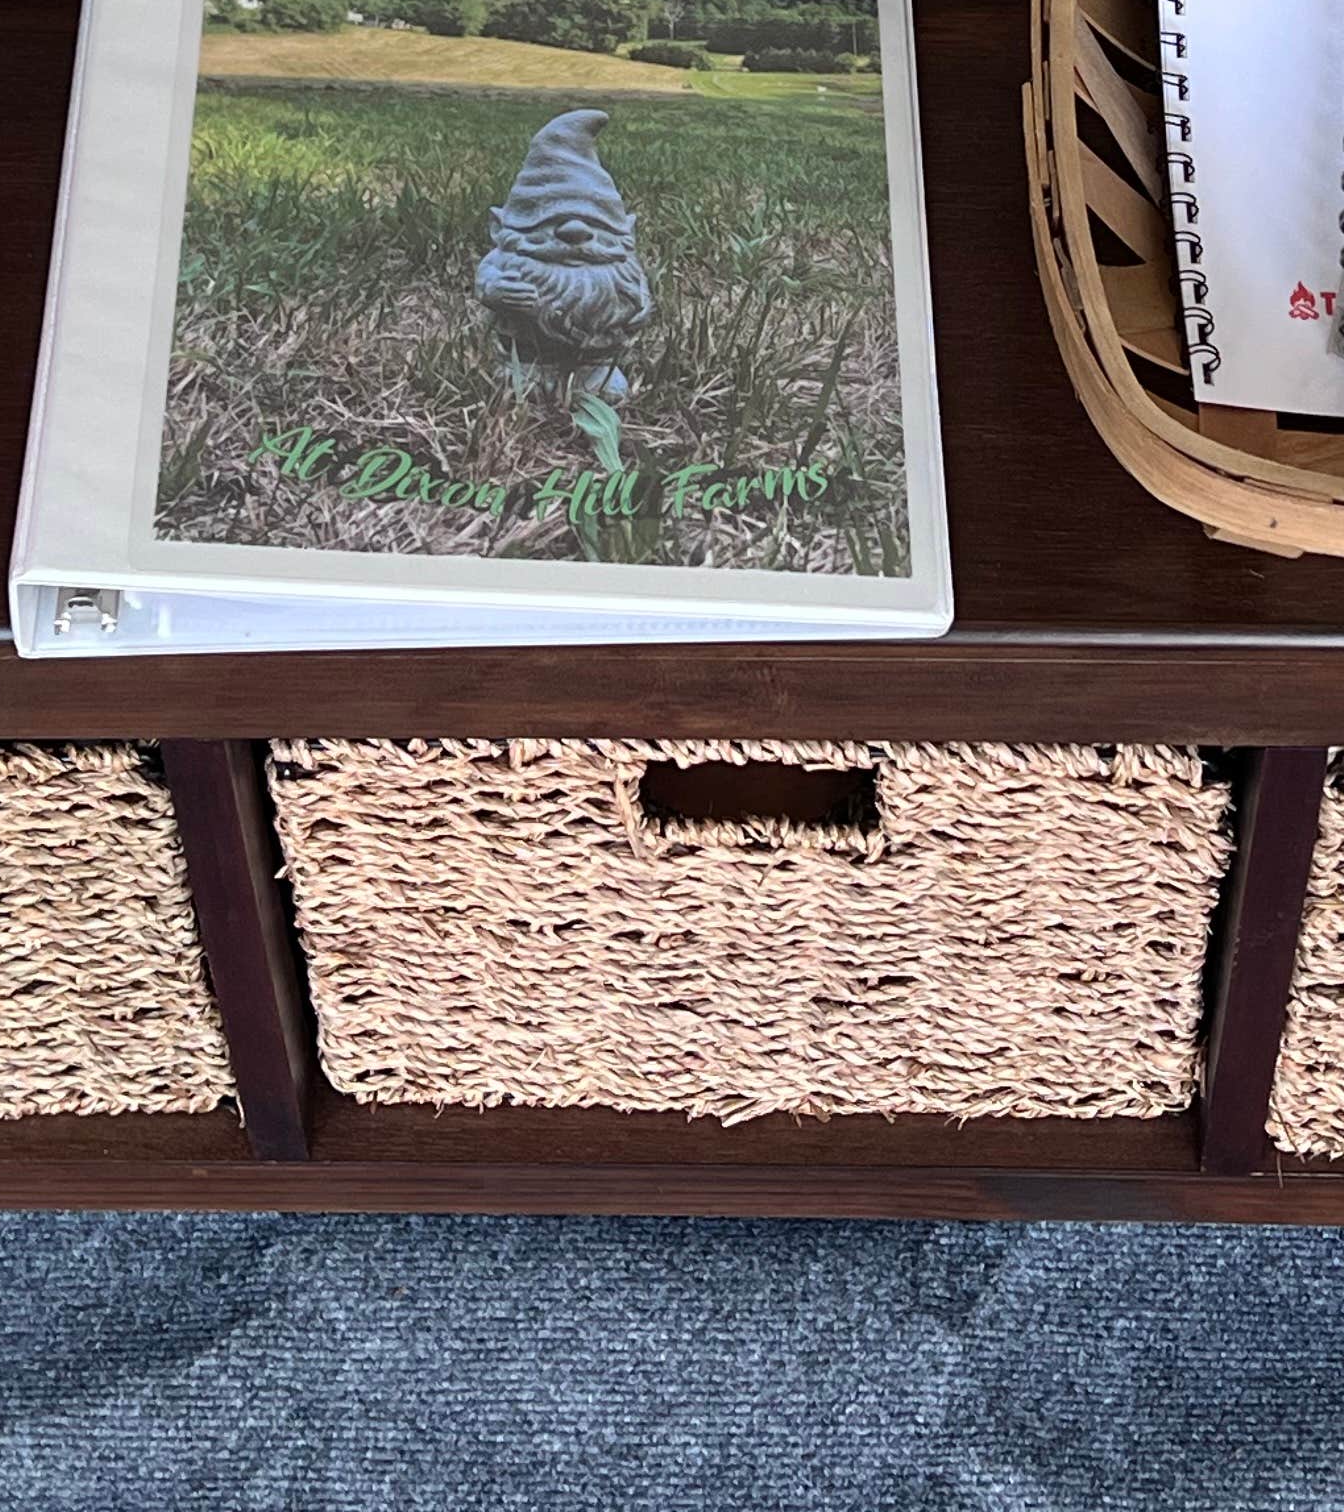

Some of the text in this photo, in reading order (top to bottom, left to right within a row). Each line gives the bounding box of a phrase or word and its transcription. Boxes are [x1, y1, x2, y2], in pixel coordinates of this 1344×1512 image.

[247, 425, 831, 525] At Dixon Hill Farms
